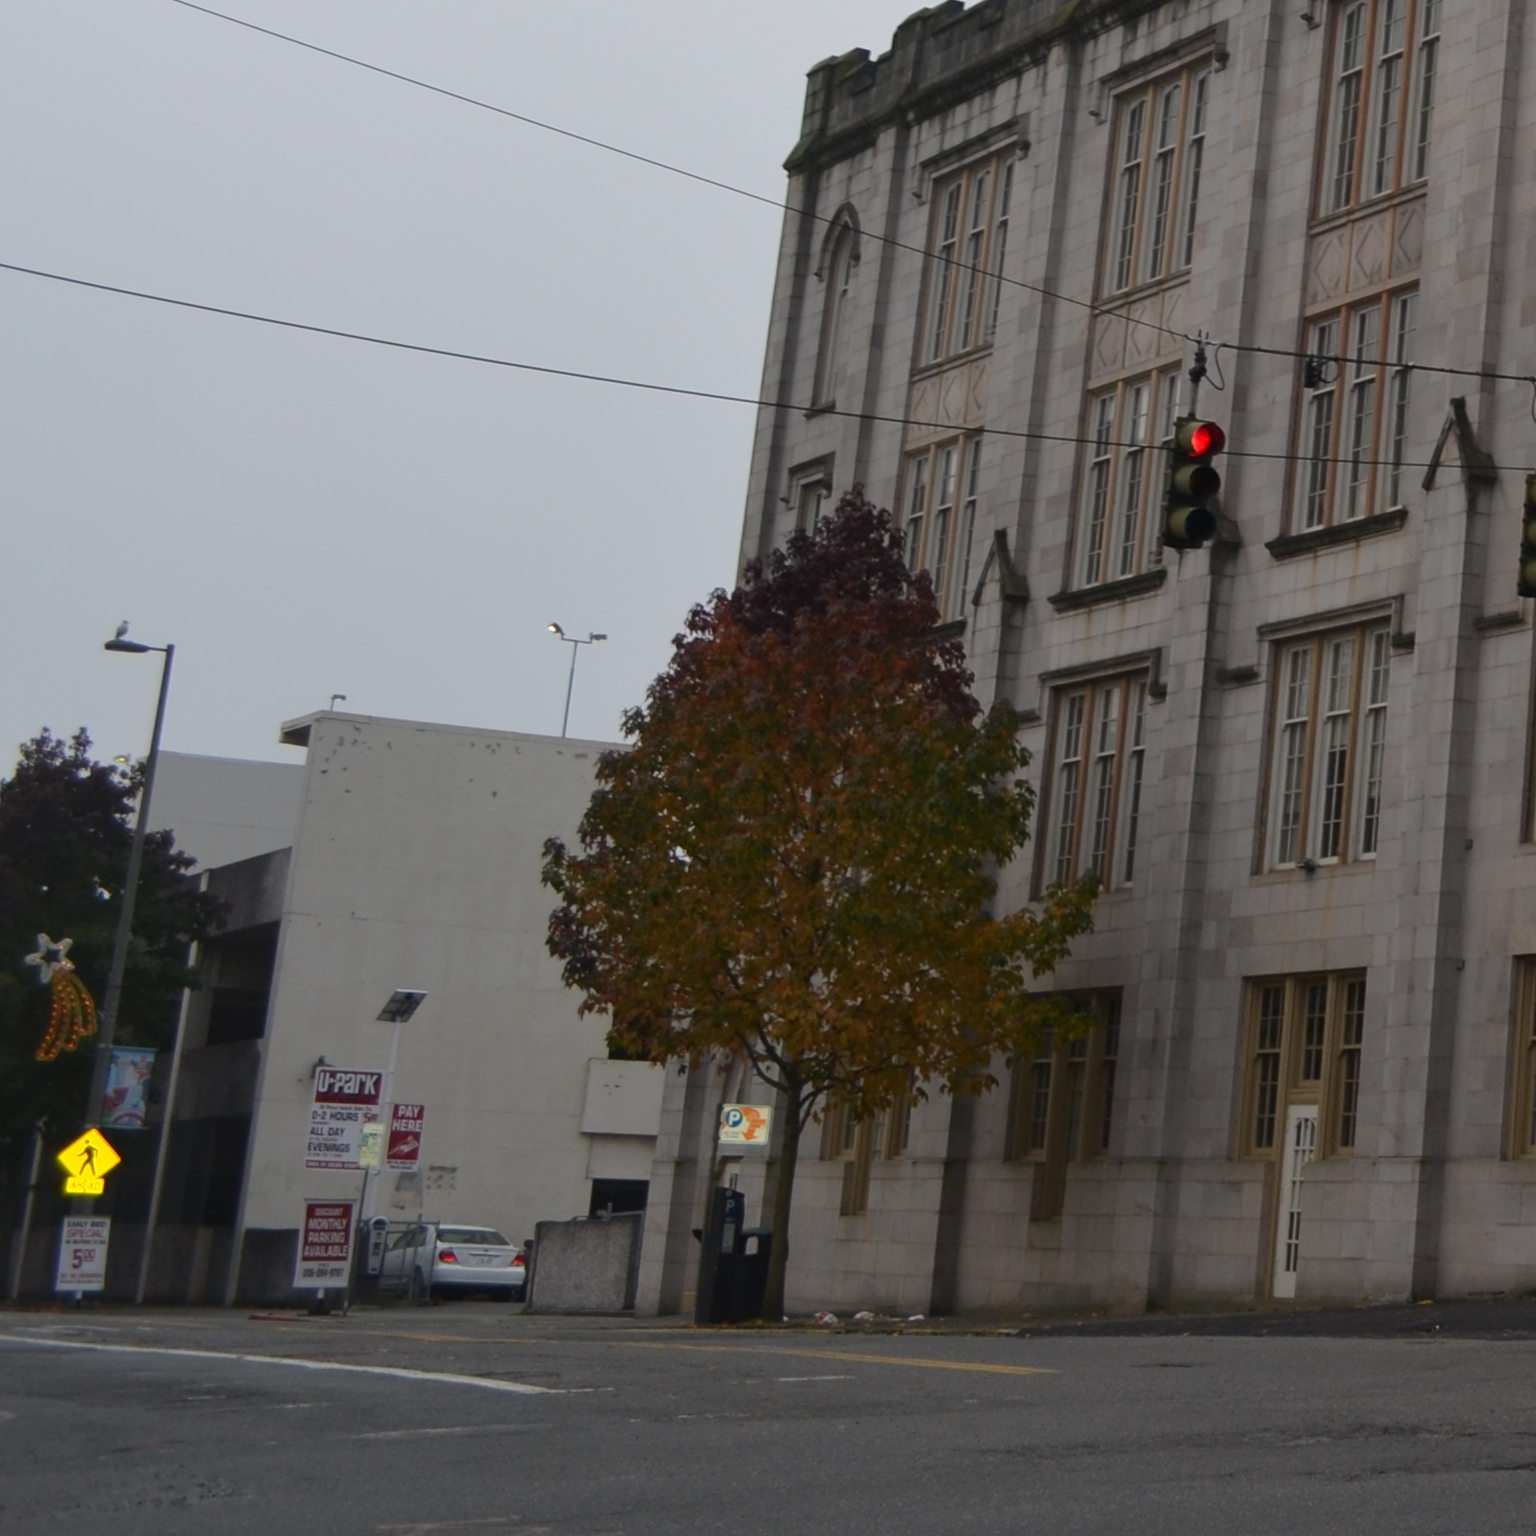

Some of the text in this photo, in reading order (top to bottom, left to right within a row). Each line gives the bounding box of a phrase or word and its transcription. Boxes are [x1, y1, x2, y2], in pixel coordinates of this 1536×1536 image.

[312, 1110, 327, 1120] 0-2
[330, 1111, 359, 1121] HOURS
[398, 1105, 421, 1118] PAY
[392, 1119, 422, 1132] HERE
[310, 1126, 346, 1137] ALL DAY
[307, 1142, 351, 1152] EVENINGS
[315, 1208, 344, 1216] DISCOUNT
[308, 1218, 348, 1230] MONTHLY
[67, 1229, 104, 1238] SPECIAL
[308, 1231, 345, 1244] PARKING
[304, 1245, 348, 1257] AVAILABLE
